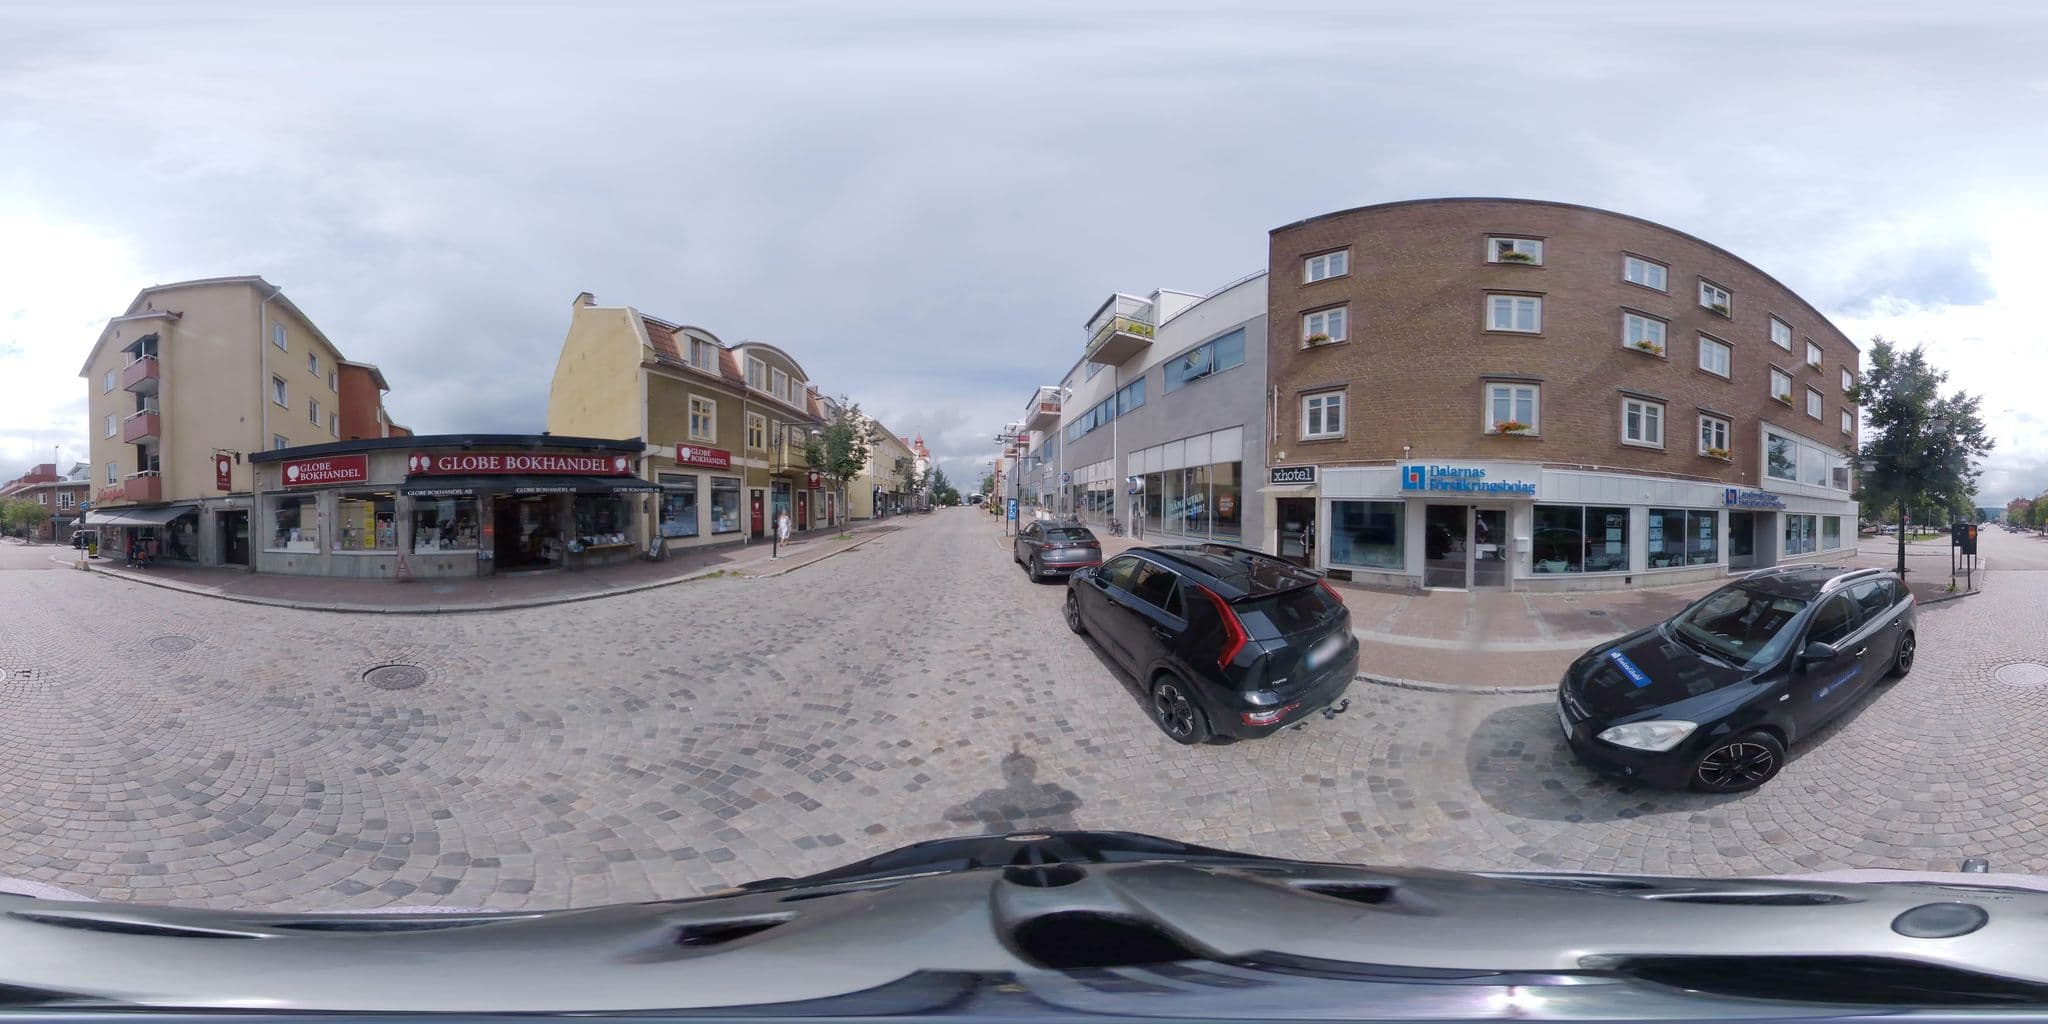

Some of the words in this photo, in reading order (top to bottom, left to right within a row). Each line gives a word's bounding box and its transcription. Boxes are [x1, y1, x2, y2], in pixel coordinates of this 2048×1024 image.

[690, 448, 711, 457] GLOBE
[300, 462, 331, 473] GLOBE
[438, 456, 500, 471] GLOBE
[506, 456, 609, 472] BOKHANDEL
[300, 468, 361, 481] BOKHANDEL
[1273, 468, 1313, 481] xhotel
[1430, 465, 1486, 478] Dalarnas
[407, 488, 427, 497] GLOBE
[516, 486, 535, 494] GLOBE
[1430, 479, 1536, 496] Försäkringsbolag
